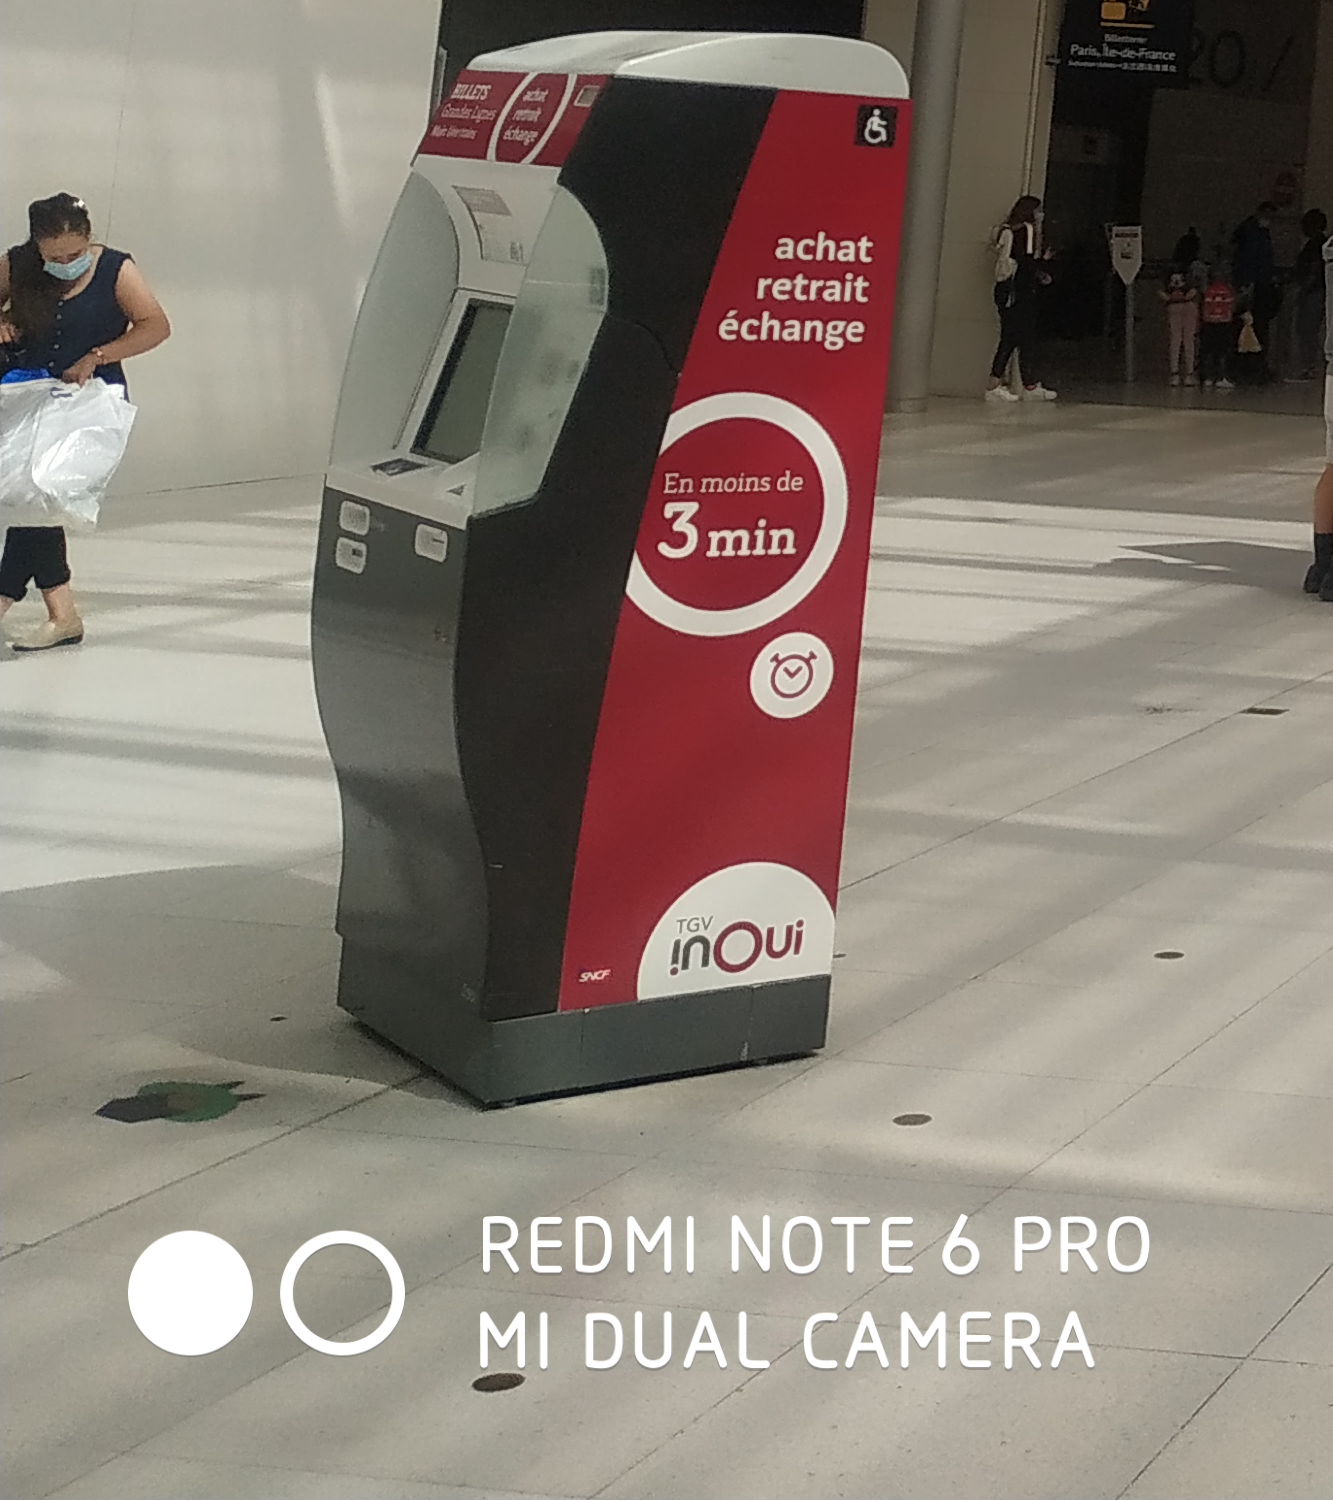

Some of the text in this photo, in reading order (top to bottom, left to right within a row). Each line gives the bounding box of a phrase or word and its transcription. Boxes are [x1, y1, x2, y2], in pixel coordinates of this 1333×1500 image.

[451, 83, 492, 101] BILLETS
[522, 87, 549, 102] achat
[512, 107, 542, 122] retrait
[502, 125, 539, 147] échange
[774, 230, 875, 265] achat
[755, 272, 871, 303] retrait
[717, 309, 867, 351] échange
[662, 469, 805, 494] En moins de
[656, 501, 798, 560] 3 min
[675, 915, 714, 935] TGV
[577, 968, 613, 983] SNCF
